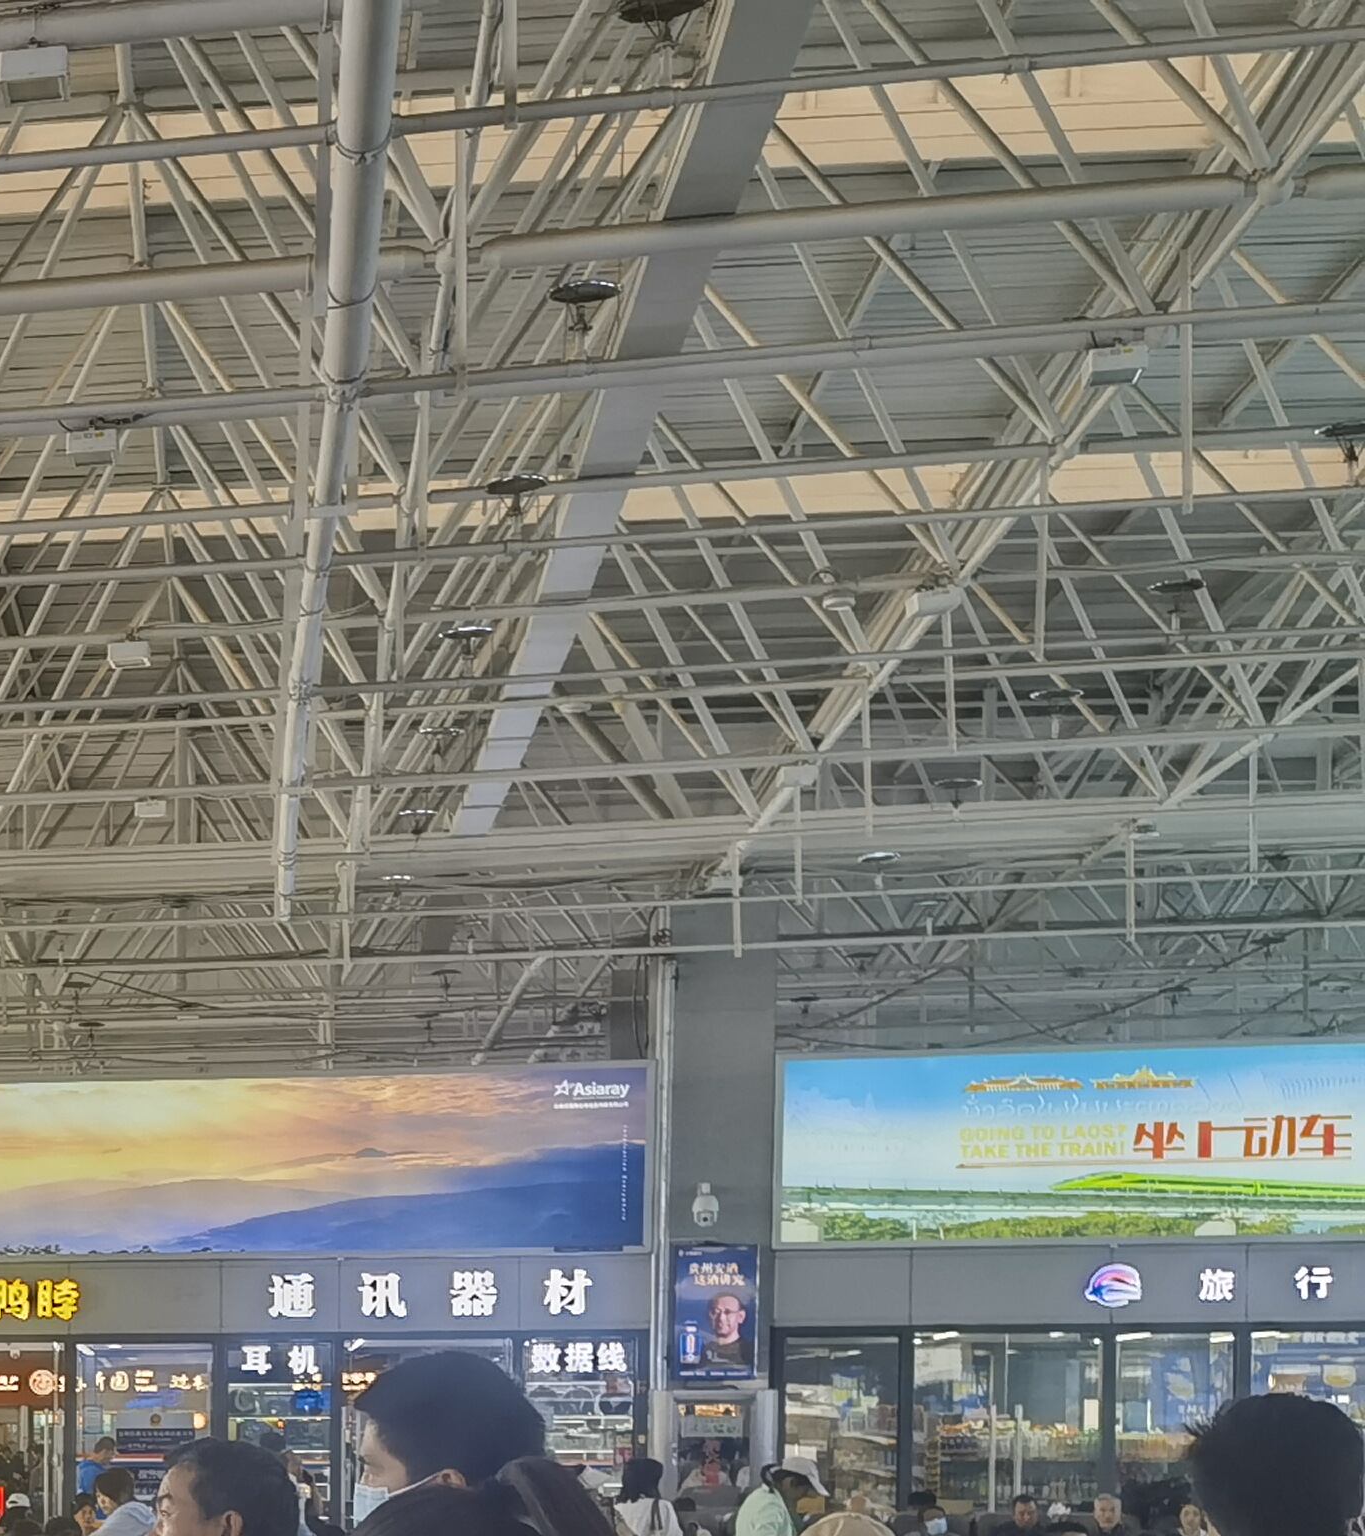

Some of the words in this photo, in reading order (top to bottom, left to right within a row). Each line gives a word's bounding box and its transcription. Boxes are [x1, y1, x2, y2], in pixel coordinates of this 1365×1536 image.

[573, 1081, 630, 1098] Asiaray
[960, 1126, 1025, 1143] GOING
[1032, 1126, 1056, 1142] TO
[960, 1143, 1010, 1159] TAKE
[1015, 1143, 1051, 1158] THE
[268, 1268, 594, 1319] 通讯器材
[1198, 1266, 1334, 1301] 旅行
[240, 1344, 319, 1376] 耳机
[531, 1341, 628, 1374] 数据线
